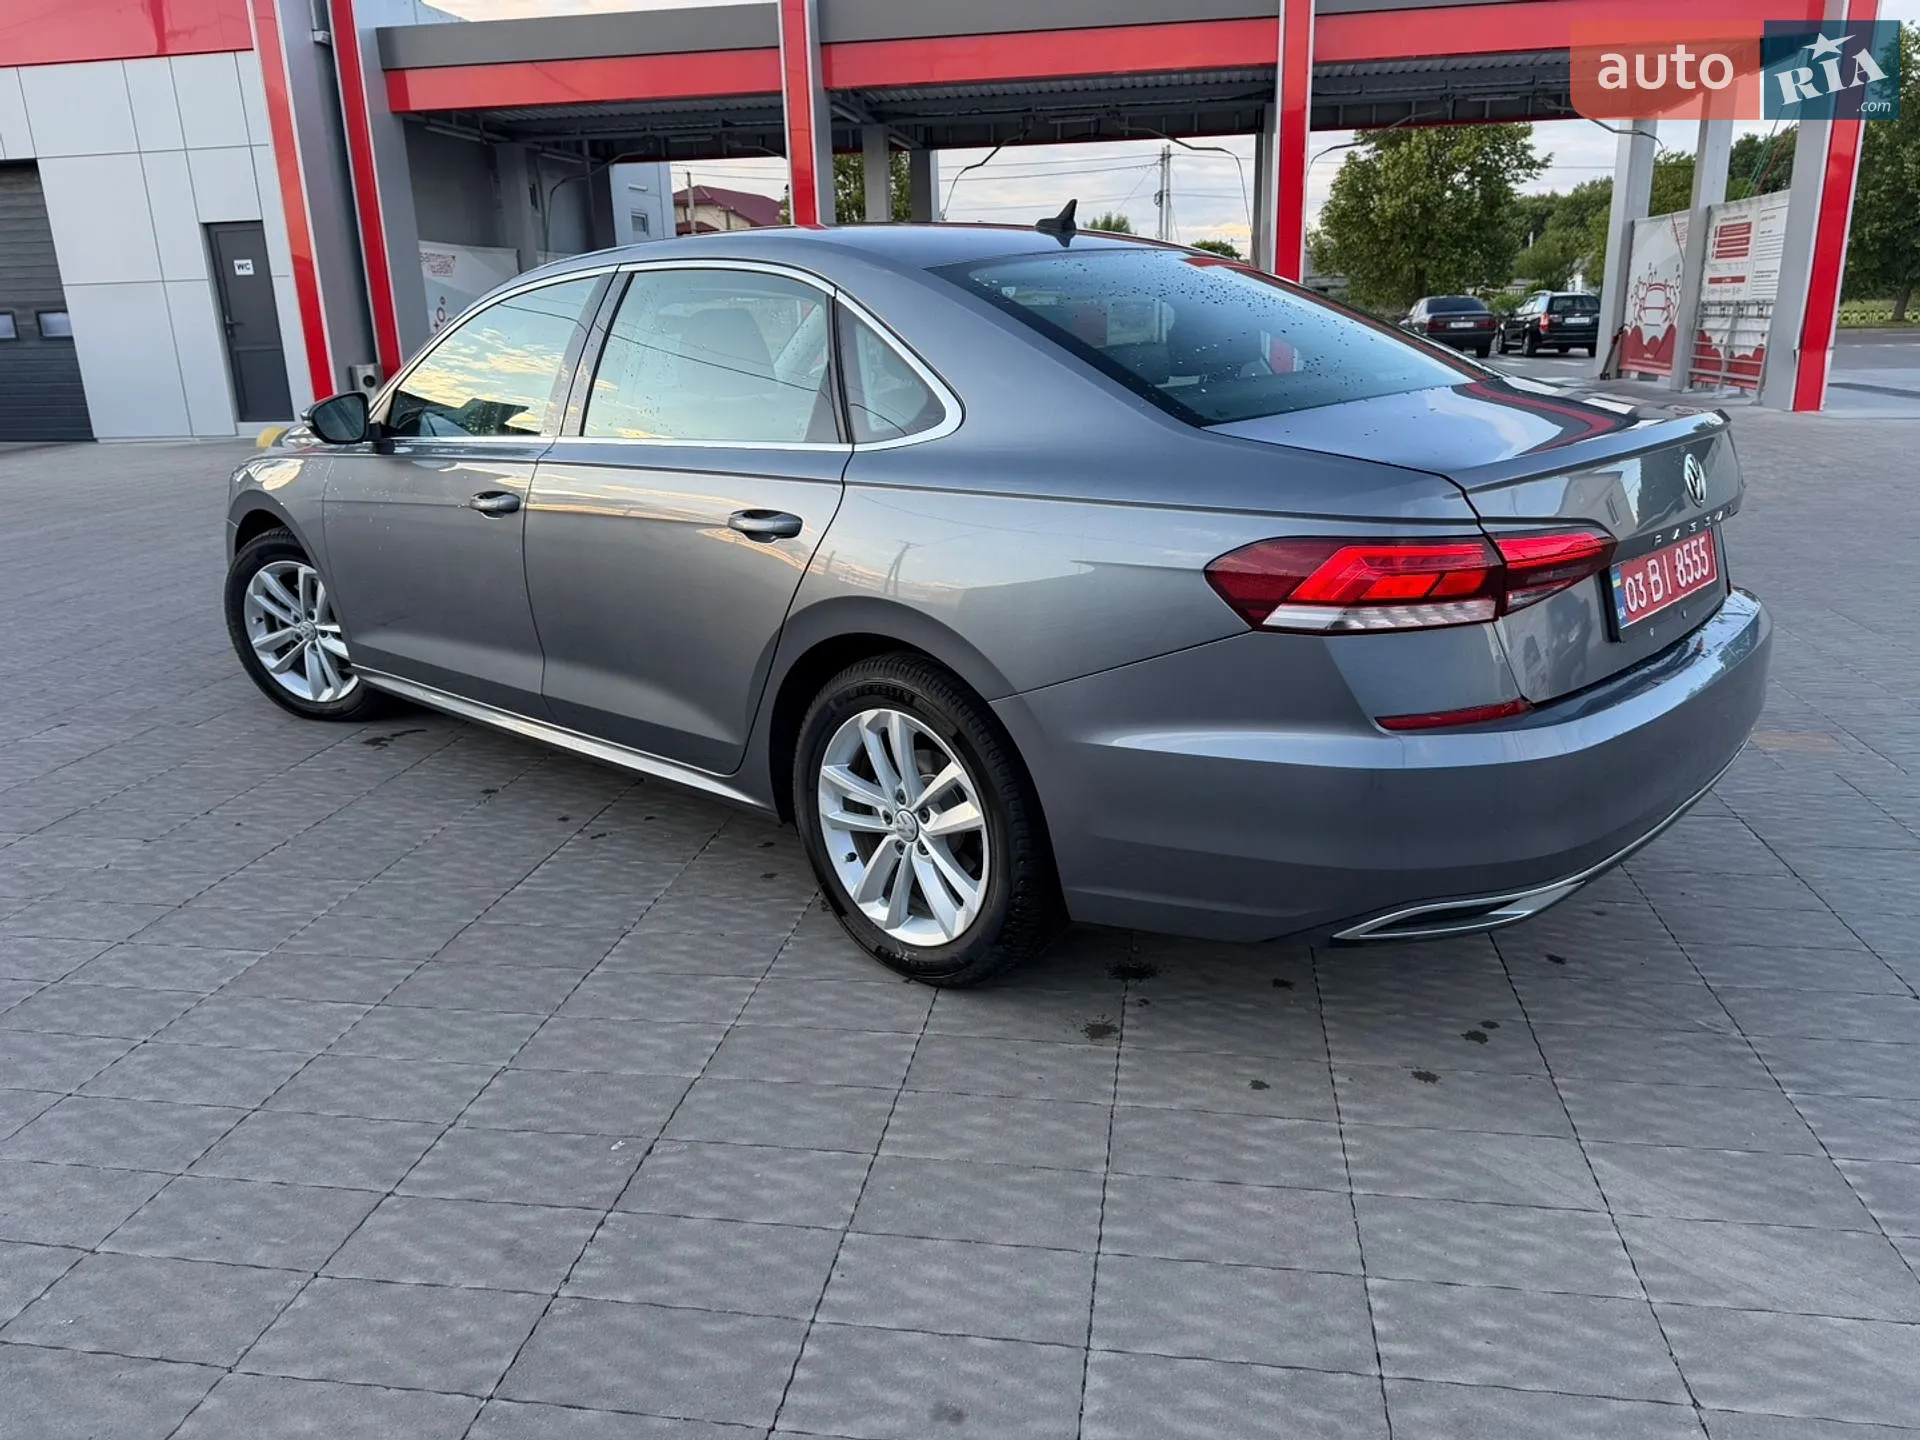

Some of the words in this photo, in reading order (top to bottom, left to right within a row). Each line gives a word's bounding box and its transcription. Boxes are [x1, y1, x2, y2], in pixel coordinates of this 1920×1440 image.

[235, 262, 252, 271] WC
[1625, 572, 1647, 612] 03
[1675, 536, 1710, 588] 8555
